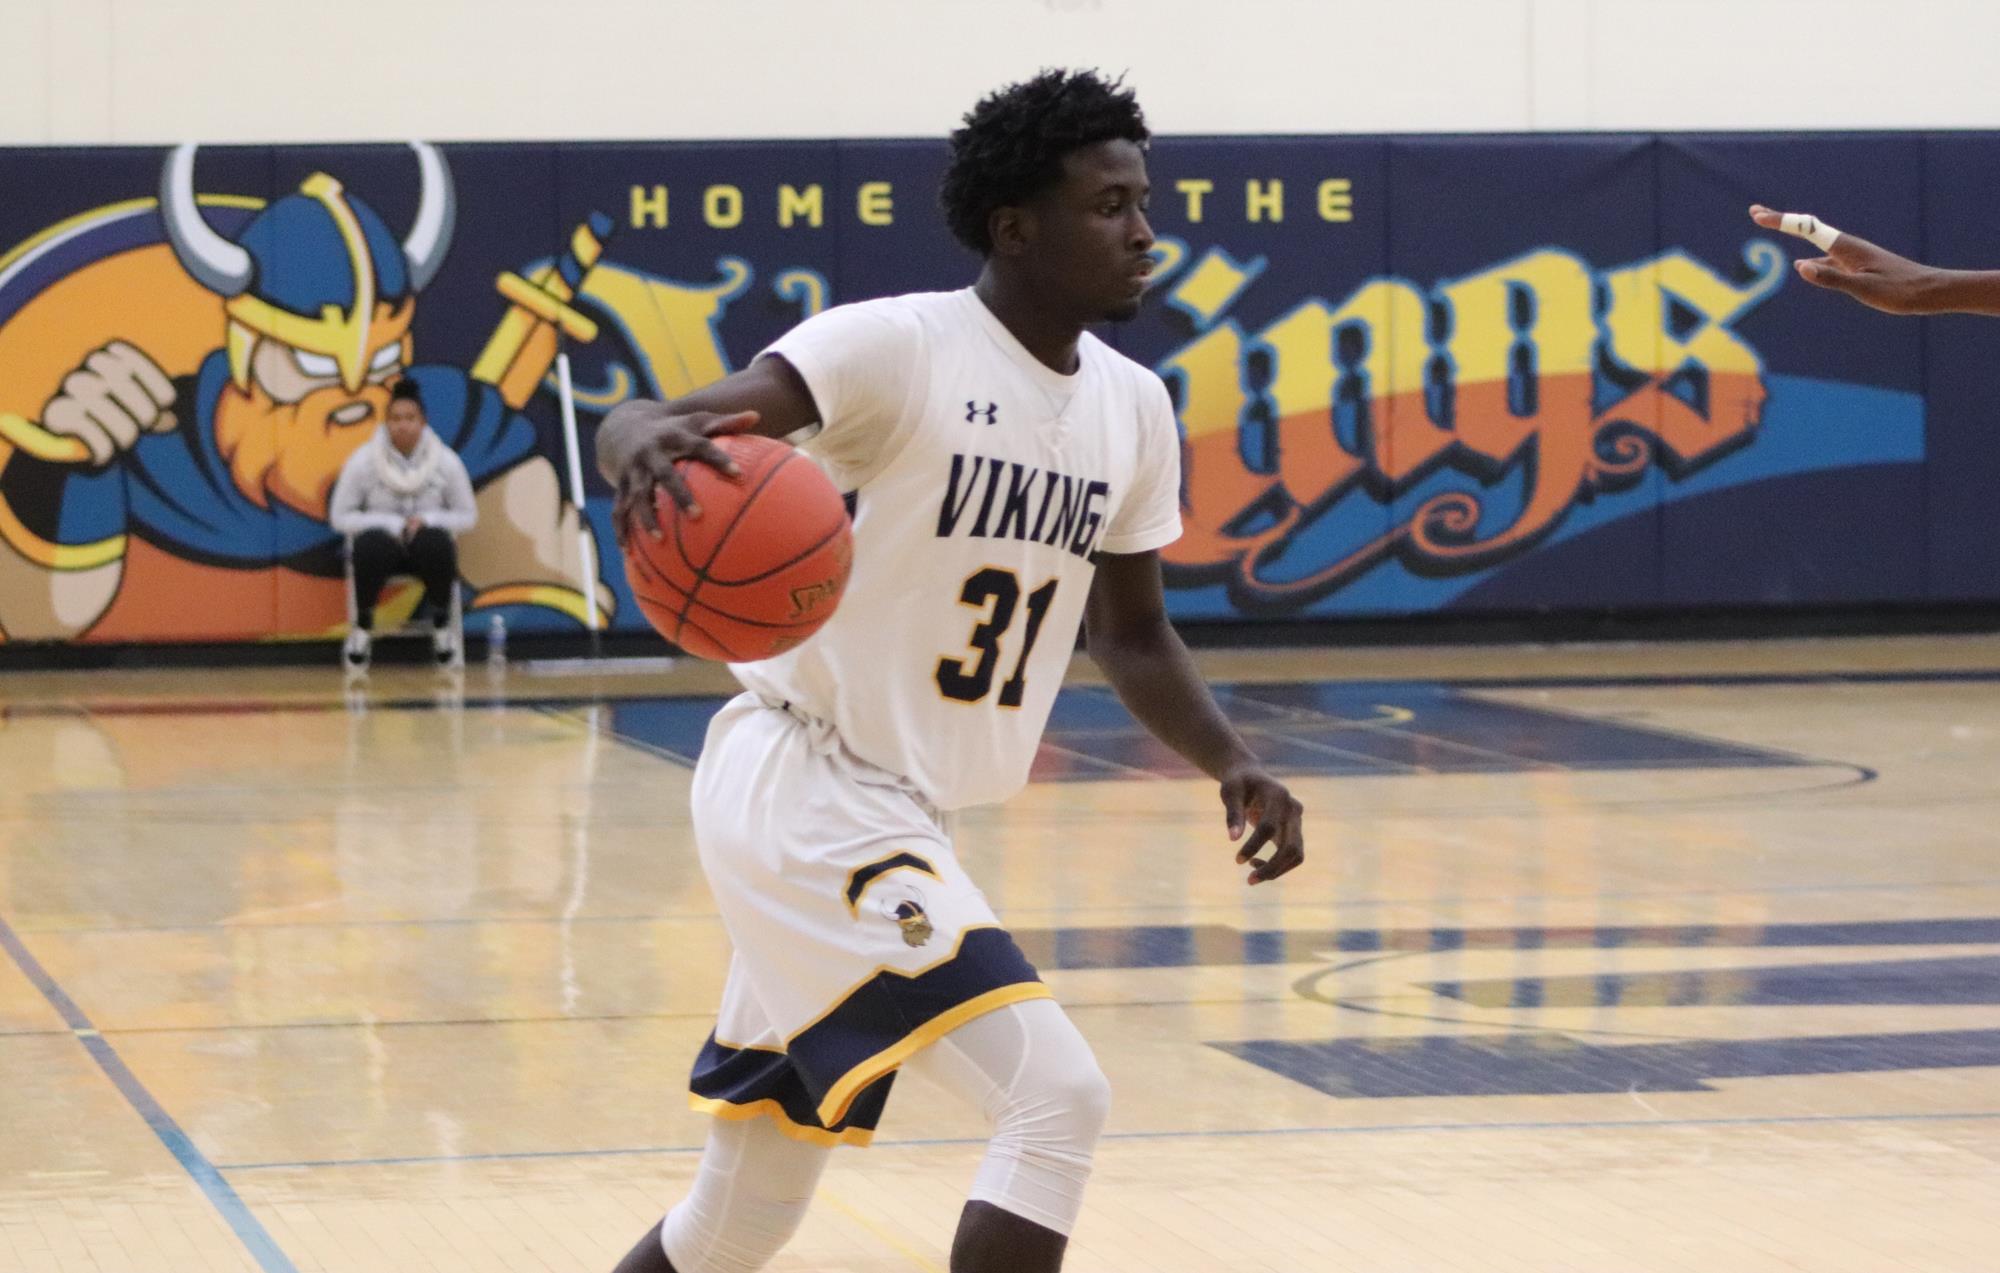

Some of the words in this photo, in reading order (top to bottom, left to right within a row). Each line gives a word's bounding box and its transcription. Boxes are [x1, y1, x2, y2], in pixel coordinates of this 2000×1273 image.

[630, 181, 894, 229] HOME
[1175, 178, 1353, 223] THE
[935, 453, 1110, 565] VIKING
[934, 564, 1060, 711] 31
